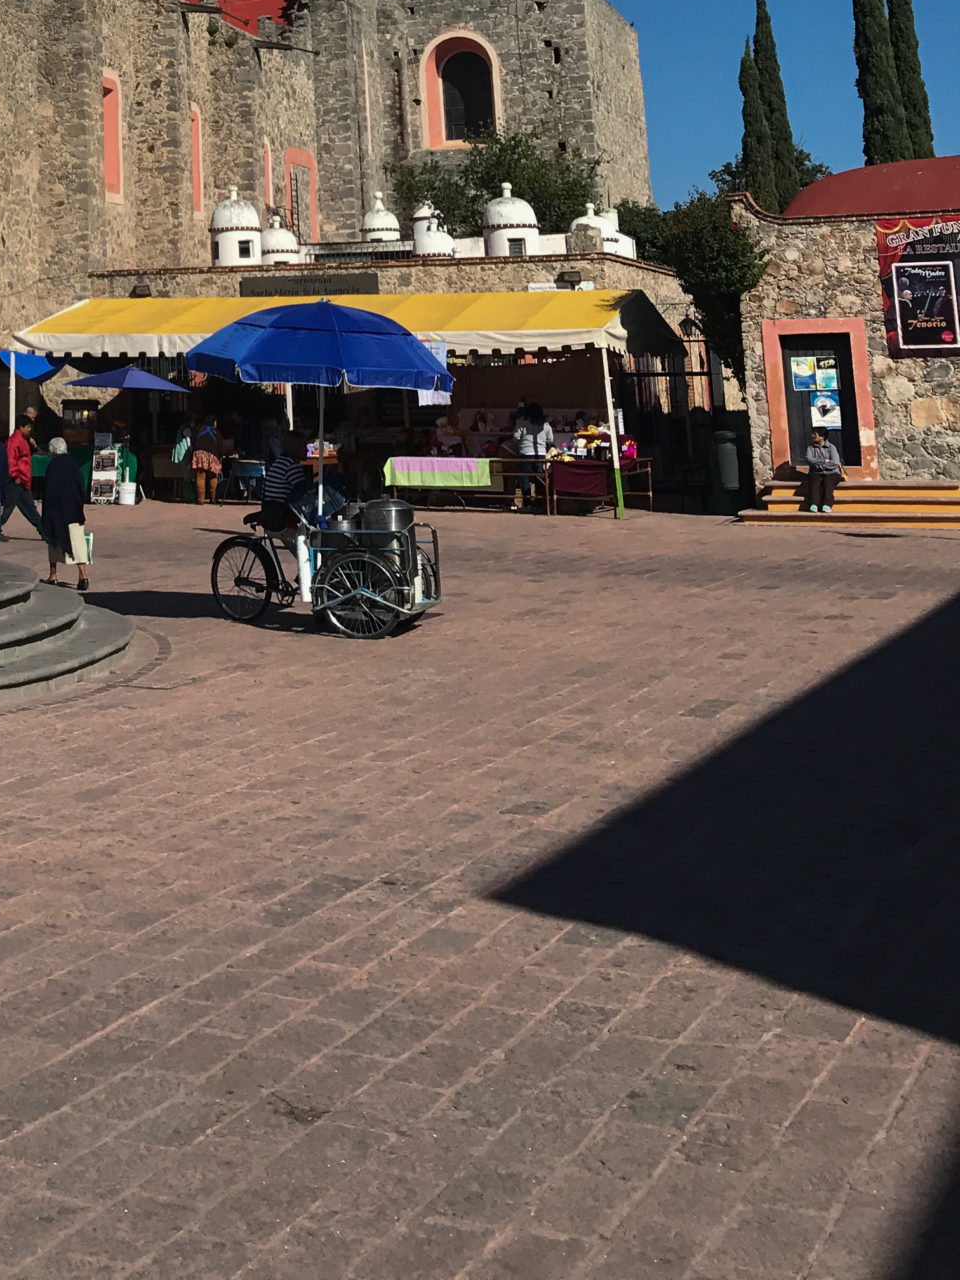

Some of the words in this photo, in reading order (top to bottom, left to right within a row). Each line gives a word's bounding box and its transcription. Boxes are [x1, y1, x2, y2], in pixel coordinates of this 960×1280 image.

[886, 226, 929, 247] GRAN
[898, 245, 914, 255] LA
[907, 319, 947, 330] Tenorio
